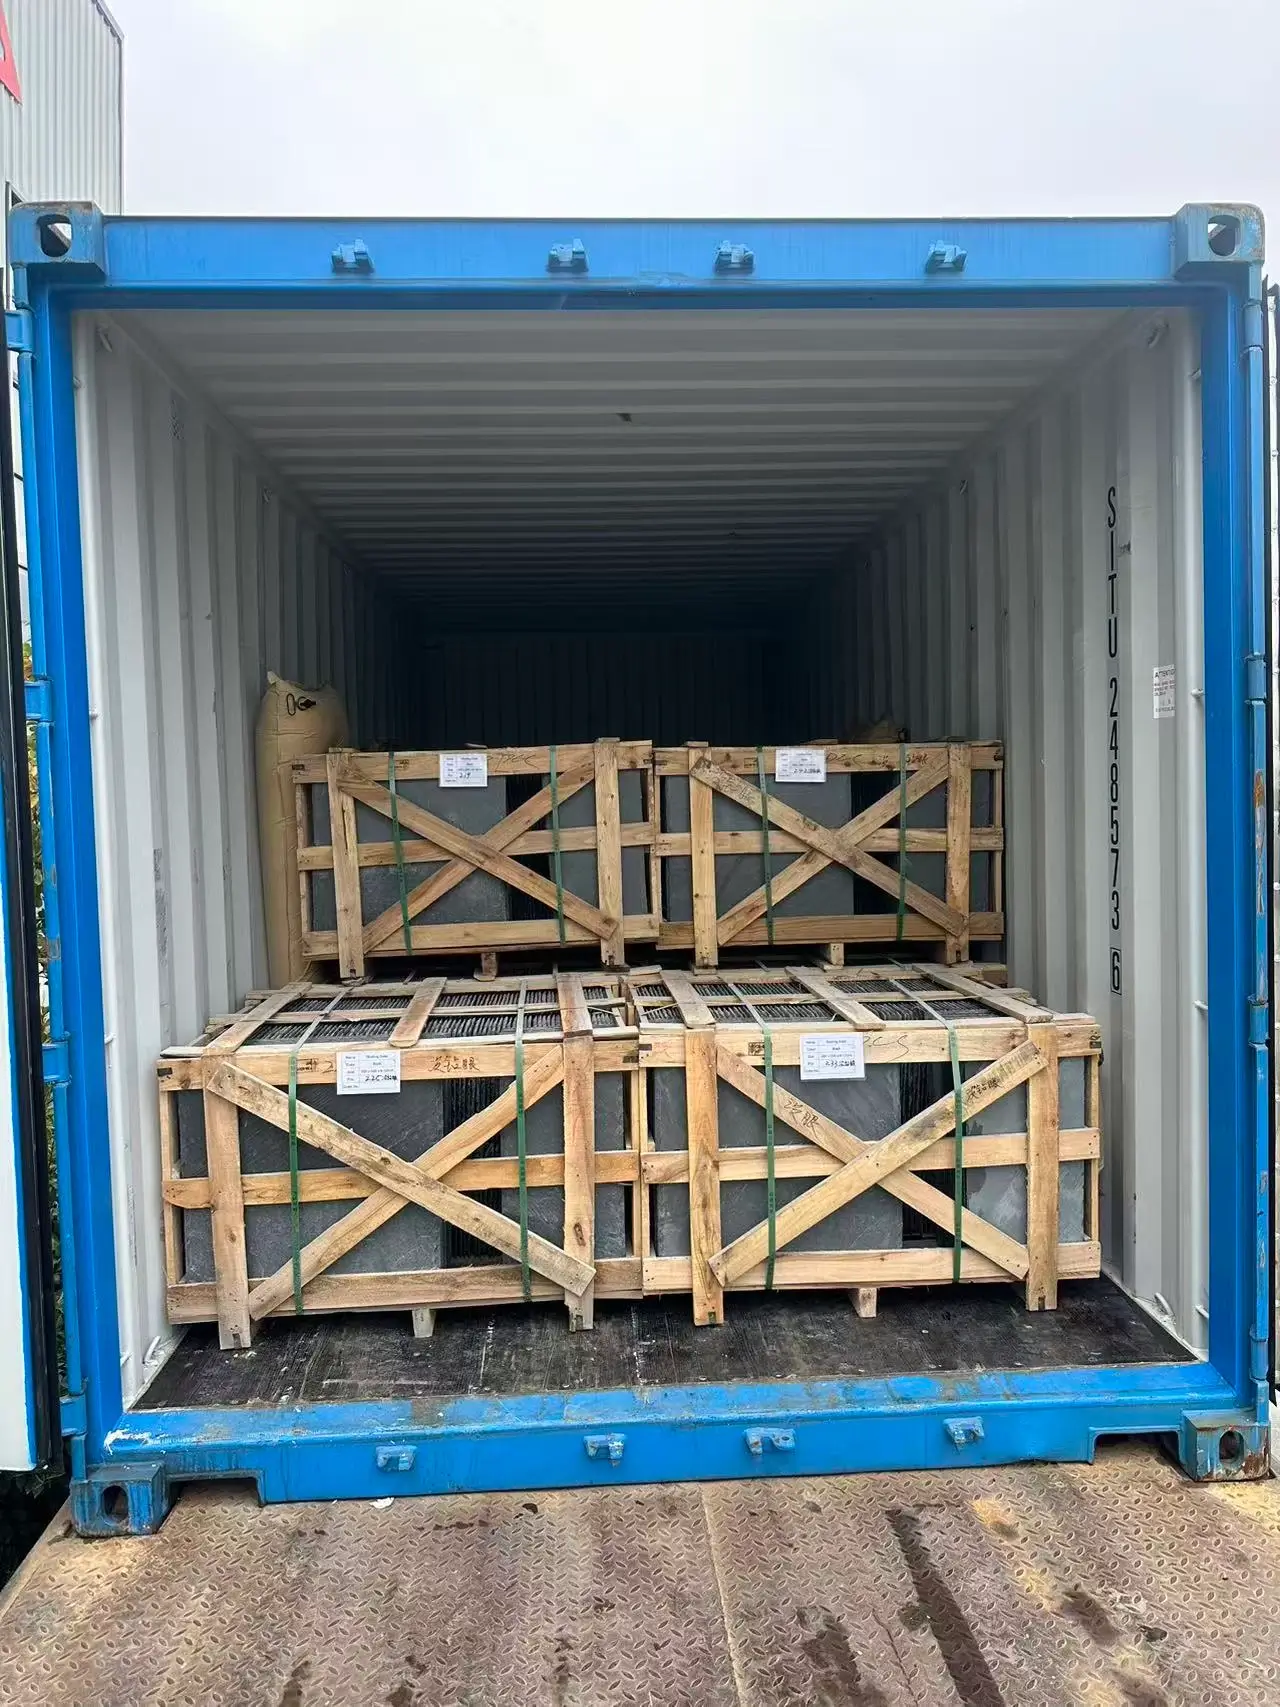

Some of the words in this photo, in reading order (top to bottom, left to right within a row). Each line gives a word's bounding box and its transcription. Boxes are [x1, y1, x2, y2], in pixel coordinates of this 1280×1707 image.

[1107, 486, 1118, 658] SITU
[1109, 677, 1120, 930] 248573
[1111, 951, 1121, 991] 6
